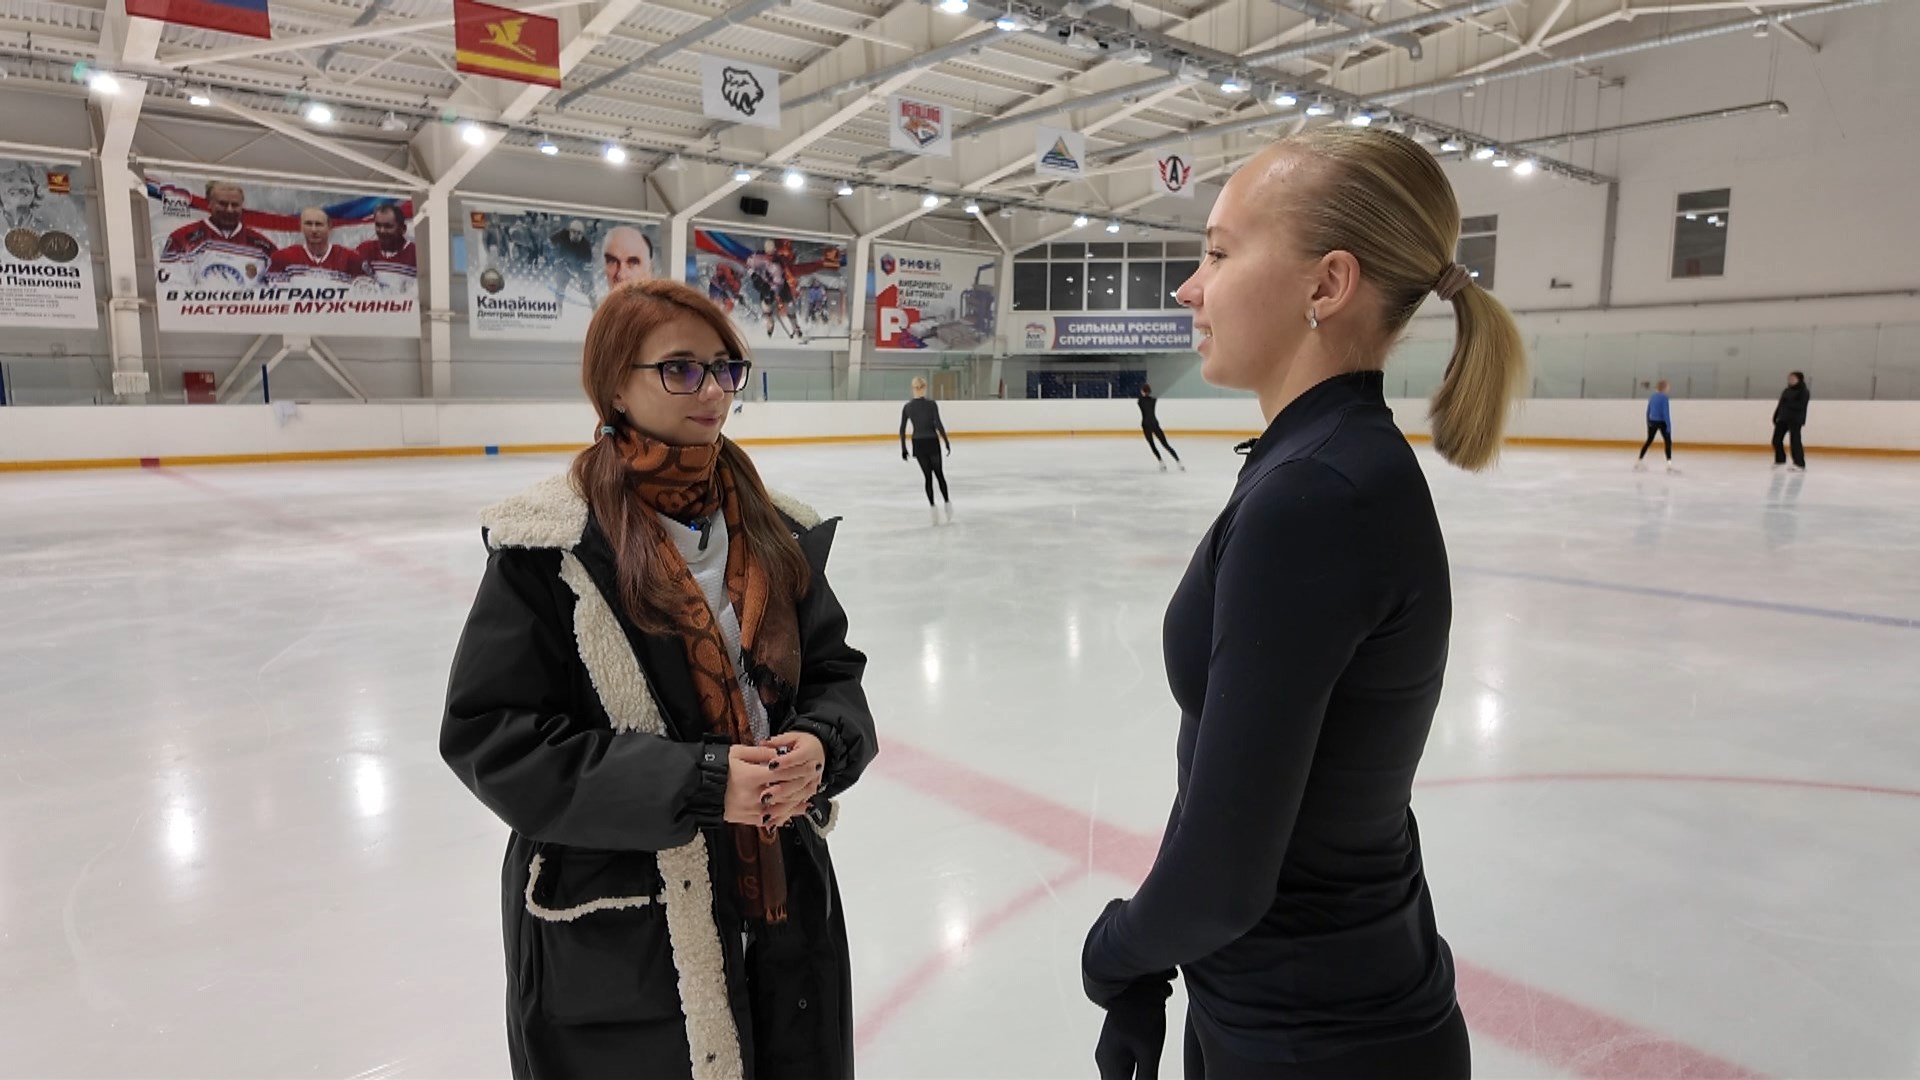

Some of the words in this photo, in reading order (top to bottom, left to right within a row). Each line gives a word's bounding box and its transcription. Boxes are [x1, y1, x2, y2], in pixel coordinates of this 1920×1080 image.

[900, 257, 941, 271] РИФЕЙ
[6, 276, 82, 289] Павловна
[166, 290, 178, 300] В
[183, 288, 255, 301] ХОККЕЙ
[259, 287, 350, 300] ИГРАЮТ
[181, 303, 290, 315] НАСТОЯЩИЕ
[293, 300, 413, 314] МУЖЧИНЫ!
[477, 295, 558, 313] Канайкин
[477, 310, 515, 319] Дмитрий
[517, 311, 558, 320] Иванович
[1068, 323, 1125, 333] СИЛЬНАЯ
[1128, 322, 1177, 332] РОССИЯ
[1059, 334, 1139, 345] СПОРТИВНАЯ
[1141, 334, 1191, 344] РОССИЯ
